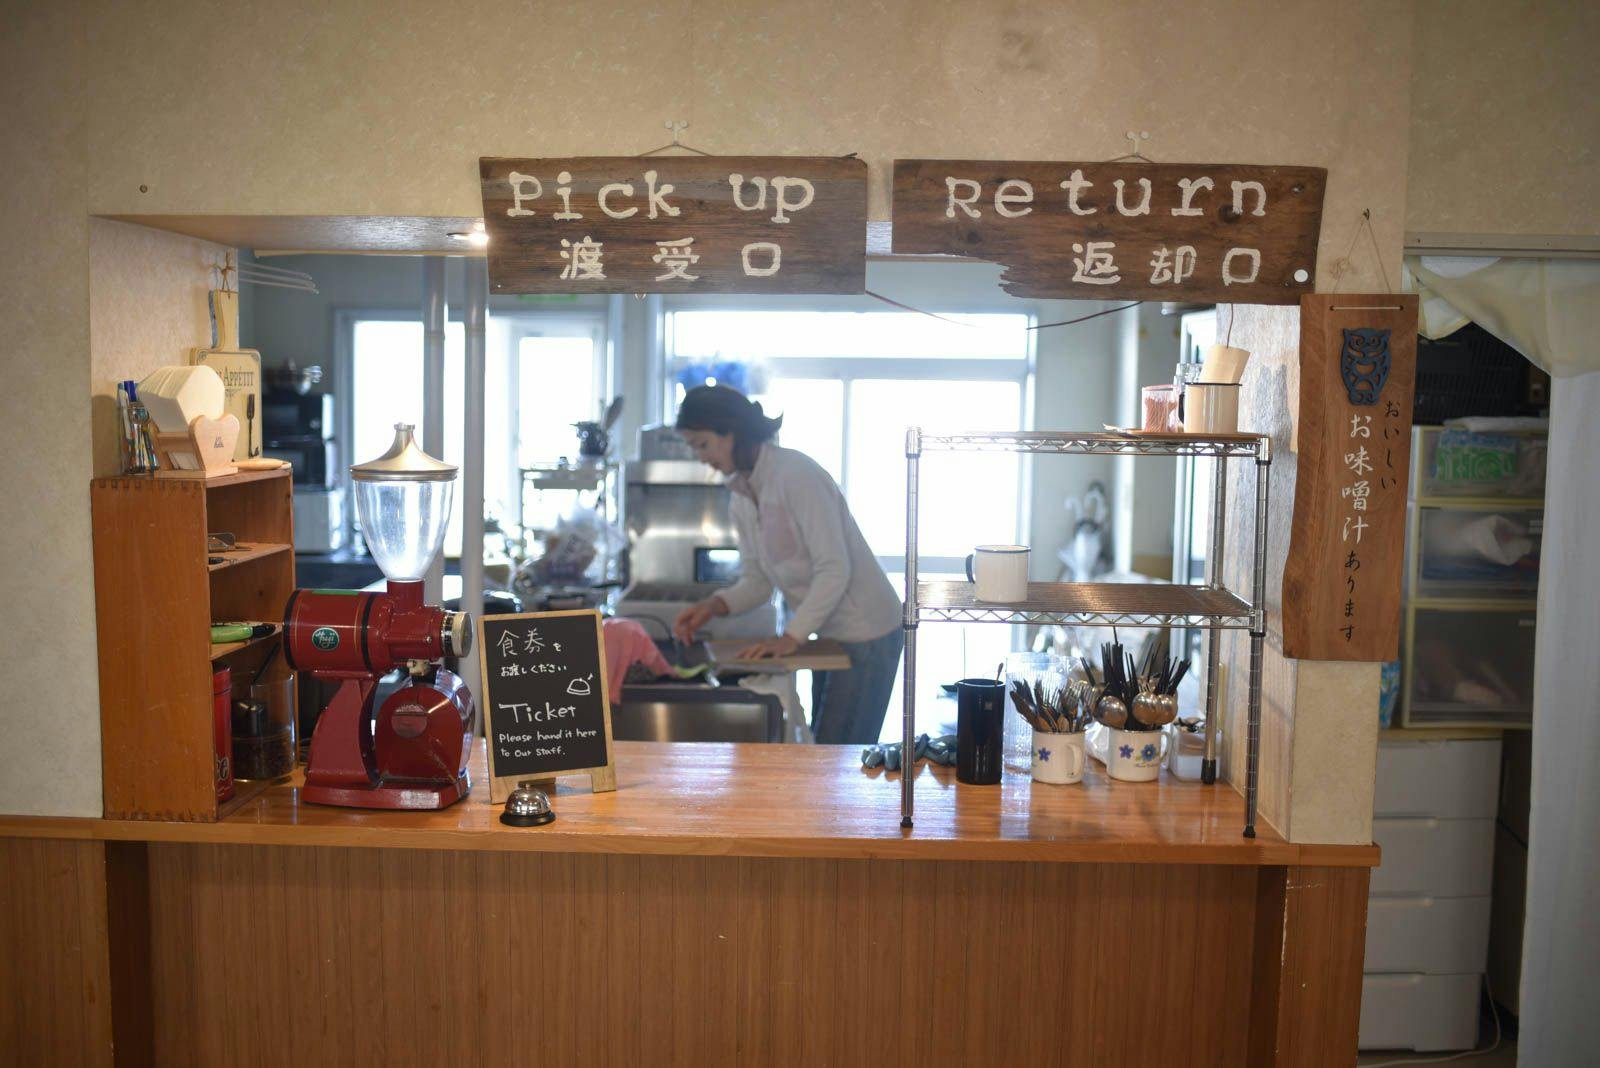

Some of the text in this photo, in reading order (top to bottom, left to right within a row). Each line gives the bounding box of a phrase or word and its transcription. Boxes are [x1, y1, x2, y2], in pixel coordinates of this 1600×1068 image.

[507, 170, 681, 220] Pick
[944, 169, 1268, 219] Return
[559, 235, 782, 282] 渡受口
[1071, 241, 1262, 286] 返却口
[1381, 400, 1401, 490] おいしい
[499, 702, 576, 723] Ticket
[537, 730, 562, 741] hand
[565, 729, 573, 738] it
[576, 728, 597, 738] here
